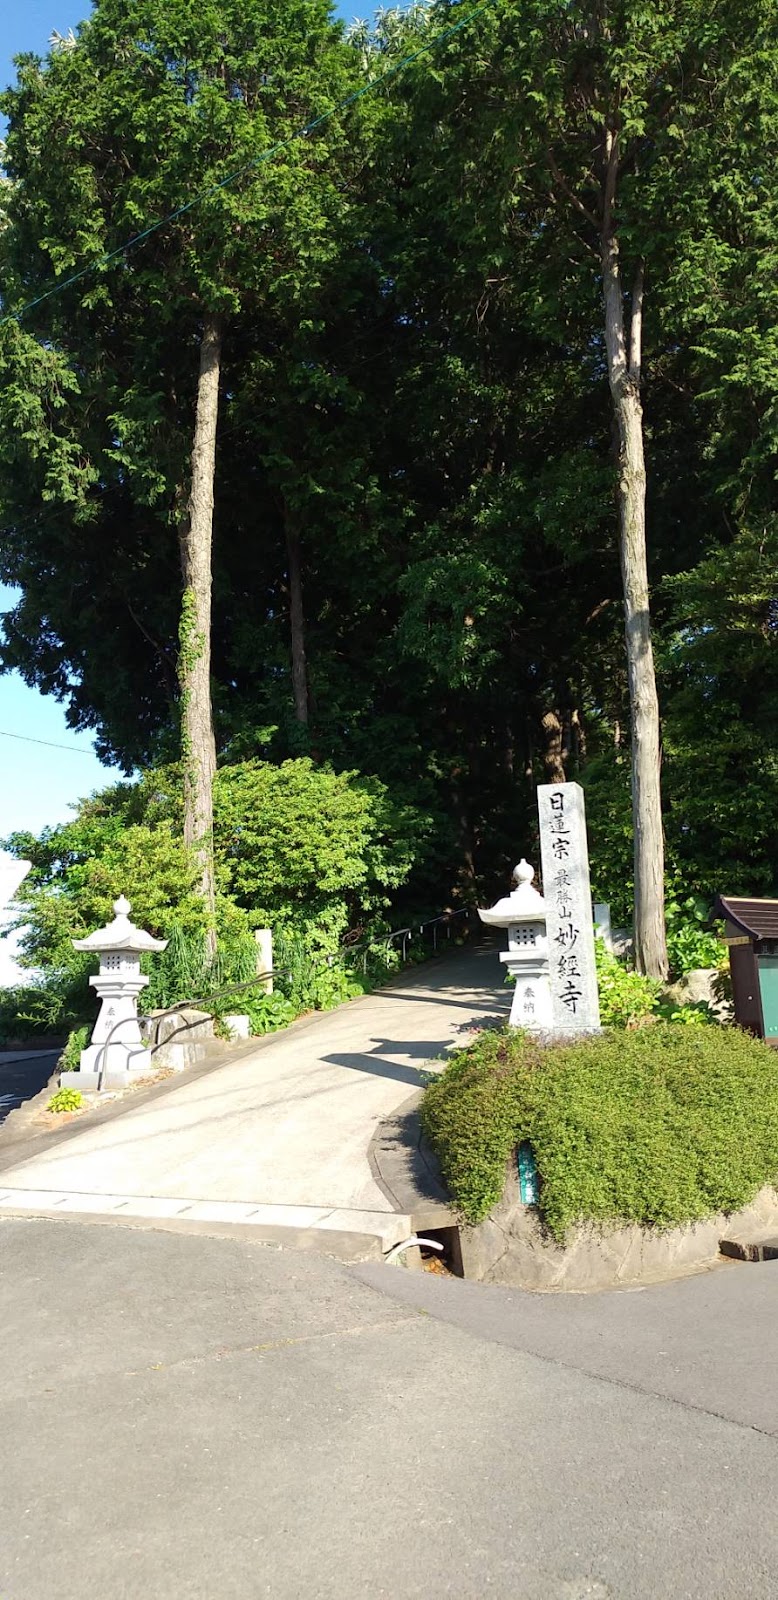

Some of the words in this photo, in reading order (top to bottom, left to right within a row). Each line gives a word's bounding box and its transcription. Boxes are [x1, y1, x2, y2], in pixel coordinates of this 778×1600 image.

[549, 792, 571, 860] 日蓮宗
[554, 868, 572, 919] 最勝山
